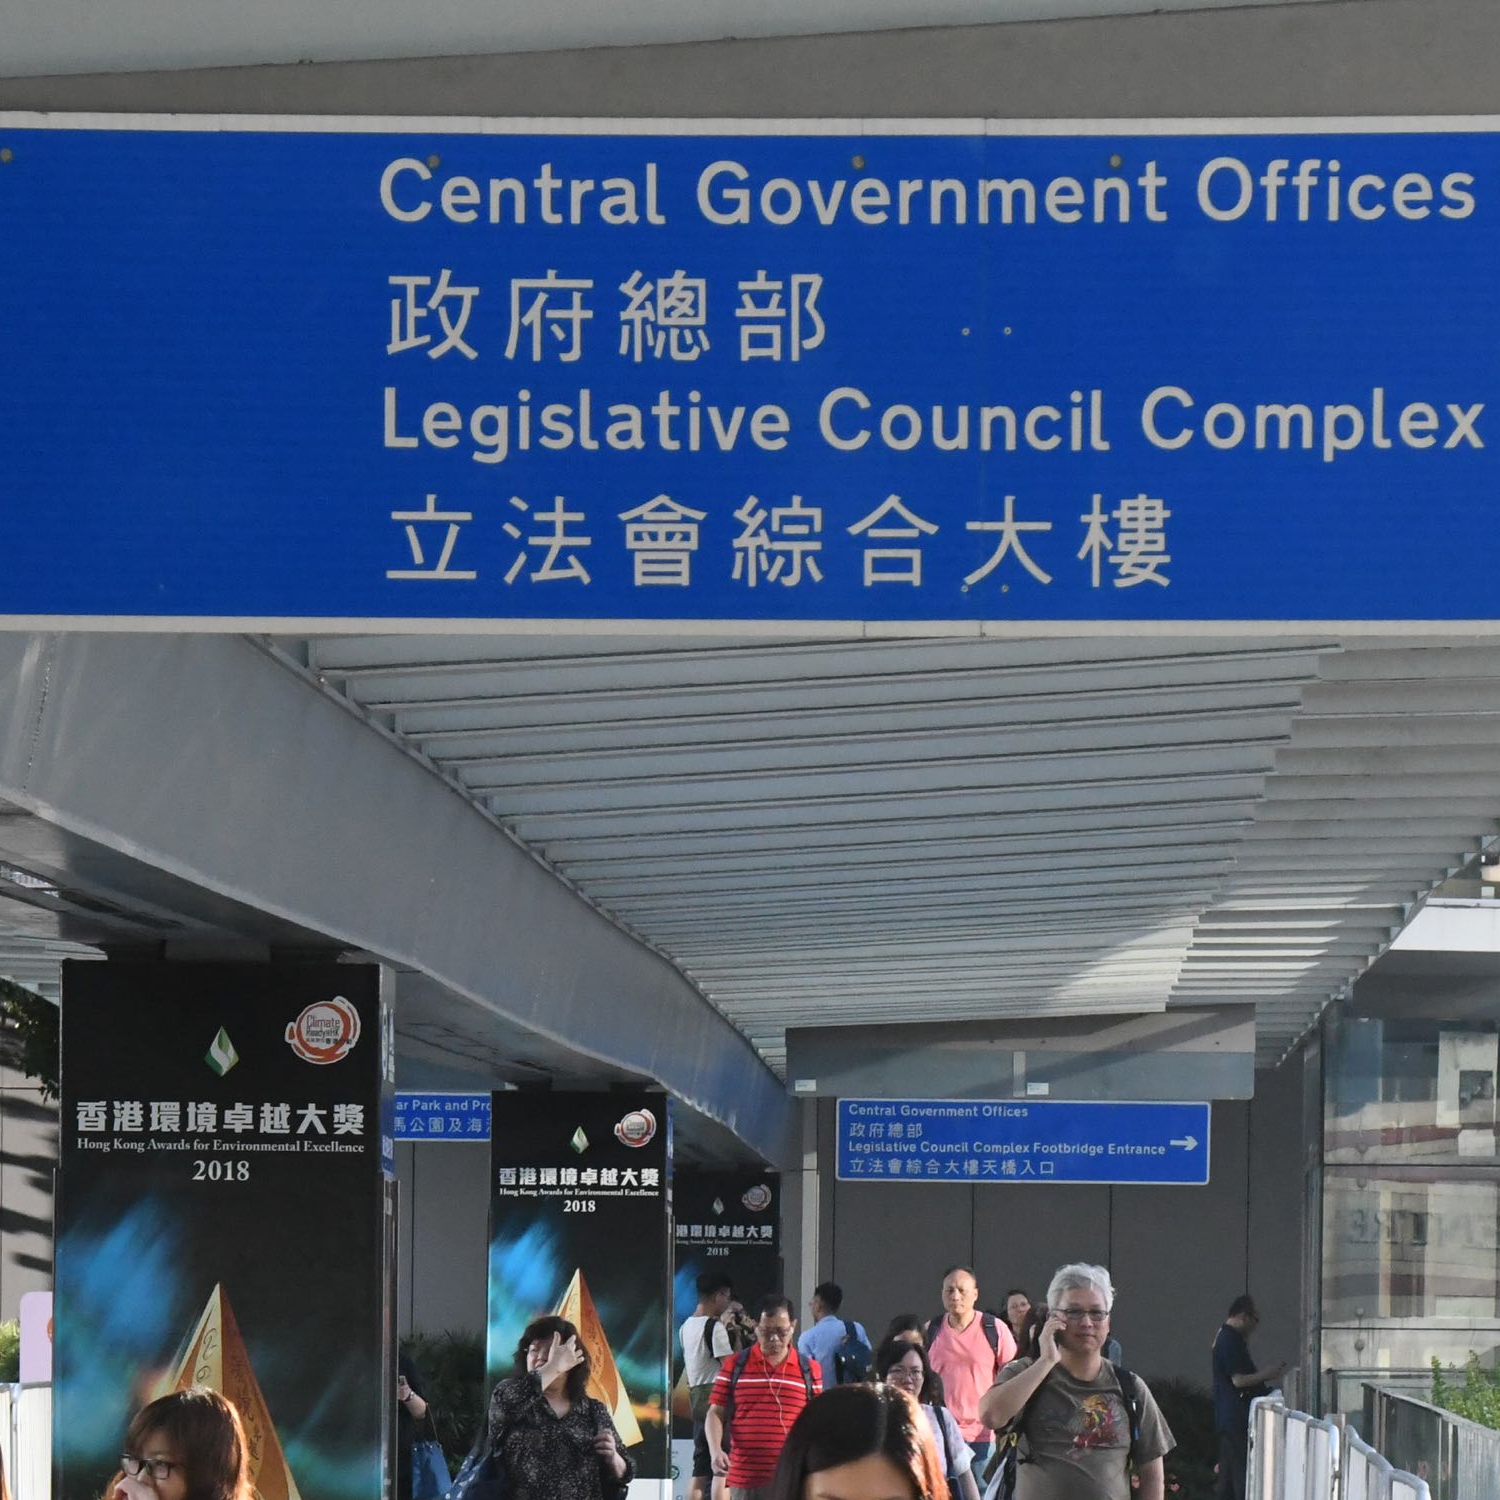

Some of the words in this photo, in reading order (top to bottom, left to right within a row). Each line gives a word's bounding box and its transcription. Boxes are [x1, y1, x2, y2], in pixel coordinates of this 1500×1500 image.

[379, 157, 666, 226] Central
[696, 156, 1167, 226] Government
[1196, 156, 1476, 222] Offices
[386, 268, 826, 363] 政府總部
[383, 386, 791, 465] Legislative
[818, 386, 1111, 452] Council
[1140, 385, 1485, 463] Complex
[385, 492, 1172, 593] 立法會綜合大樓
[306, 1014, 340, 1028] Climate
[396, 1102, 408, 1111] ar
[412, 1099, 441, 1111] Park
[444, 1100, 468, 1111] and
[472, 1100, 491, 1111] Pro
[848, 1103, 896, 1116] Central
[900, 1104, 978, 1118] Government
[76, 1100, 365, 1136] 香港環境卓越大獎
[394, 1116, 491, 1133] 馬公園及海
[849, 1122, 923, 1139] 政府總部
[76, 1137, 111, 1153] Hong
[113, 1137, 145, 1153] Kong
[147, 1138, 191, 1152] Awards
[193, 1138, 211, 1152] for
[212, 1139, 301, 1153] Environmental
[303, 1140, 365, 1153] Excellence
[848, 1140, 917, 1155] Legislative
[920, 1141, 969, 1154] Council
[972, 1141, 1030, 1155] Complex
[1033, 1142, 1104, 1157] Footbridge
[1108, 1143, 1167, 1156] Entrance
[191, 1160, 250, 1182] 2018
[849, 1157, 1056, 1176] 立法會綜合大樓天橋入口
[499, 1167, 660, 1187] 香港環境卓越大獎
[499, 1187, 519, 1198] Hong
[519, 1187, 538, 1198] Kong
[538, 1188, 564, 1197] Awards
[564, 1187, 574, 1197] for
[574, 1188, 624, 1197] Environmental
[624, 1188, 660, 1198] Excellence
[563, 1200, 597, 1214] 2018
[706, 1246, 730, 1256] 2018
